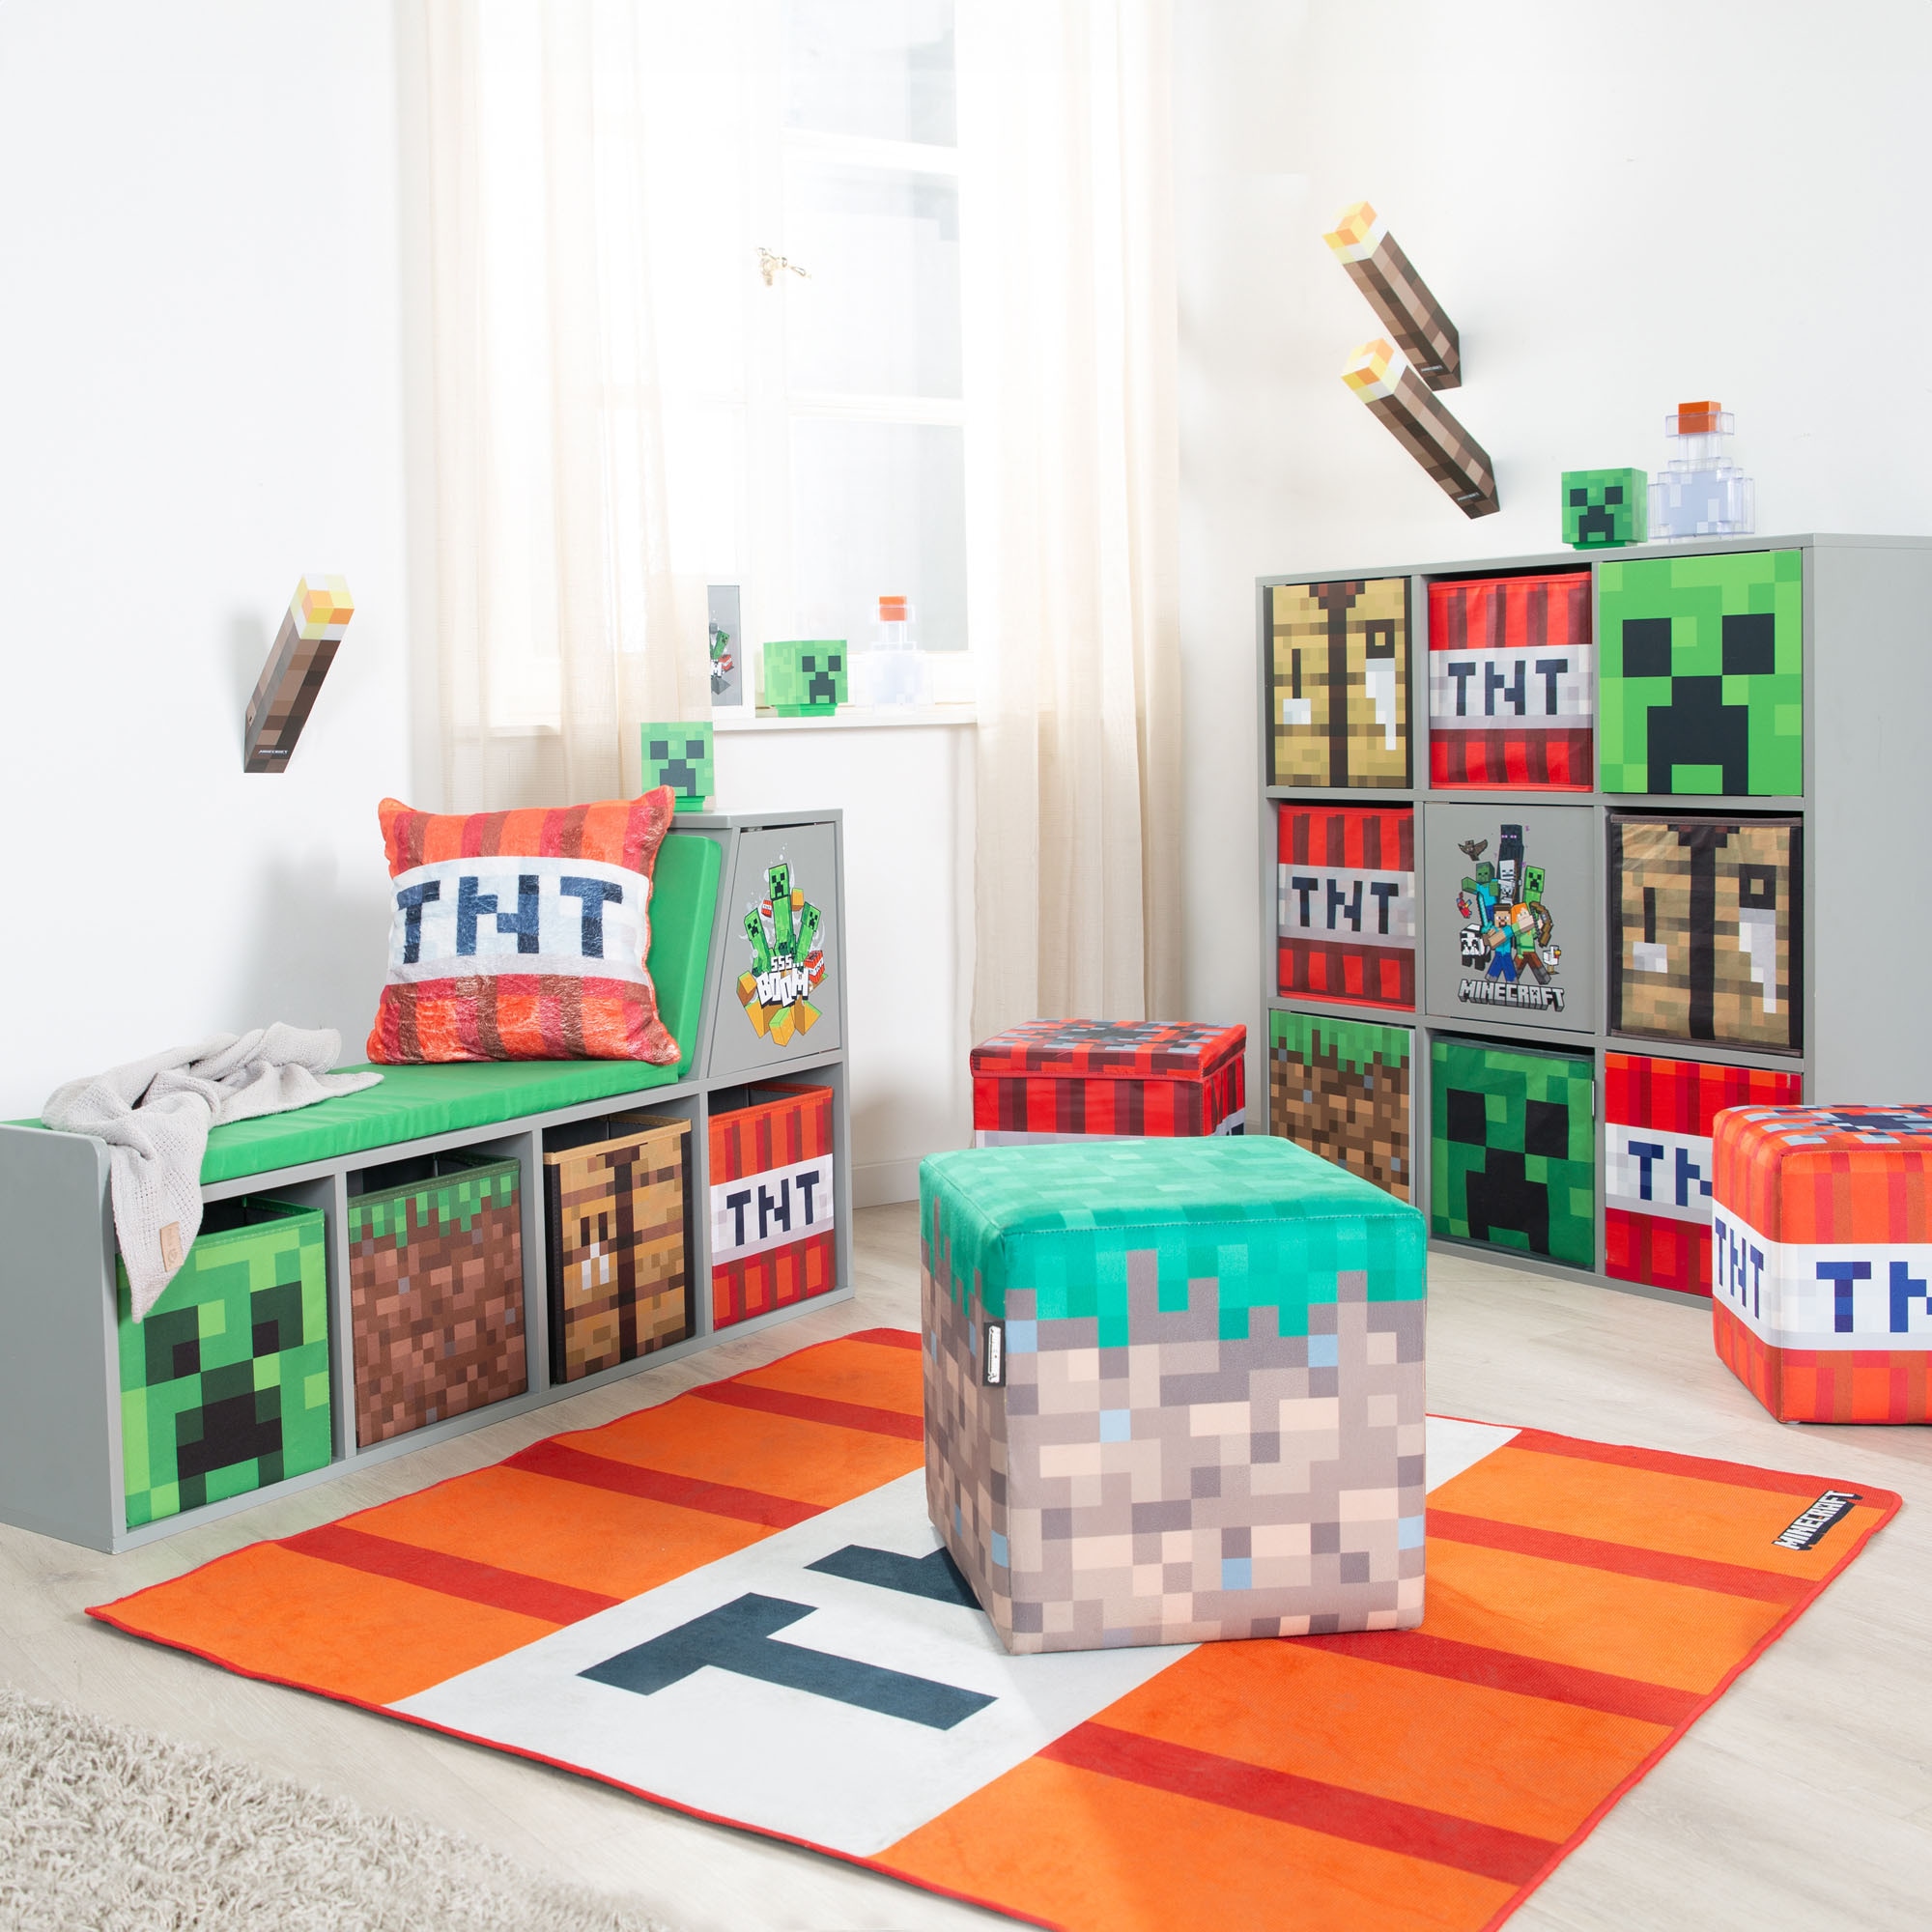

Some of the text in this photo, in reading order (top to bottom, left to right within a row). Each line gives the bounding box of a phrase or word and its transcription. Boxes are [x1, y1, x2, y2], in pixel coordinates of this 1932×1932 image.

[1448, 659, 1568, 716] TNT
[396, 874, 623, 964] TNT
[1292, 876, 1399, 934] TNT
[756, 967, 810, 1008] BOOM
[1459, 980, 1565, 1009] MINECRAFT
[725, 1170, 820, 1247] TNT
[1715, 1216, 1764, 1320] TNT
[1772, 1489, 1860, 1550] MINECRAFT
